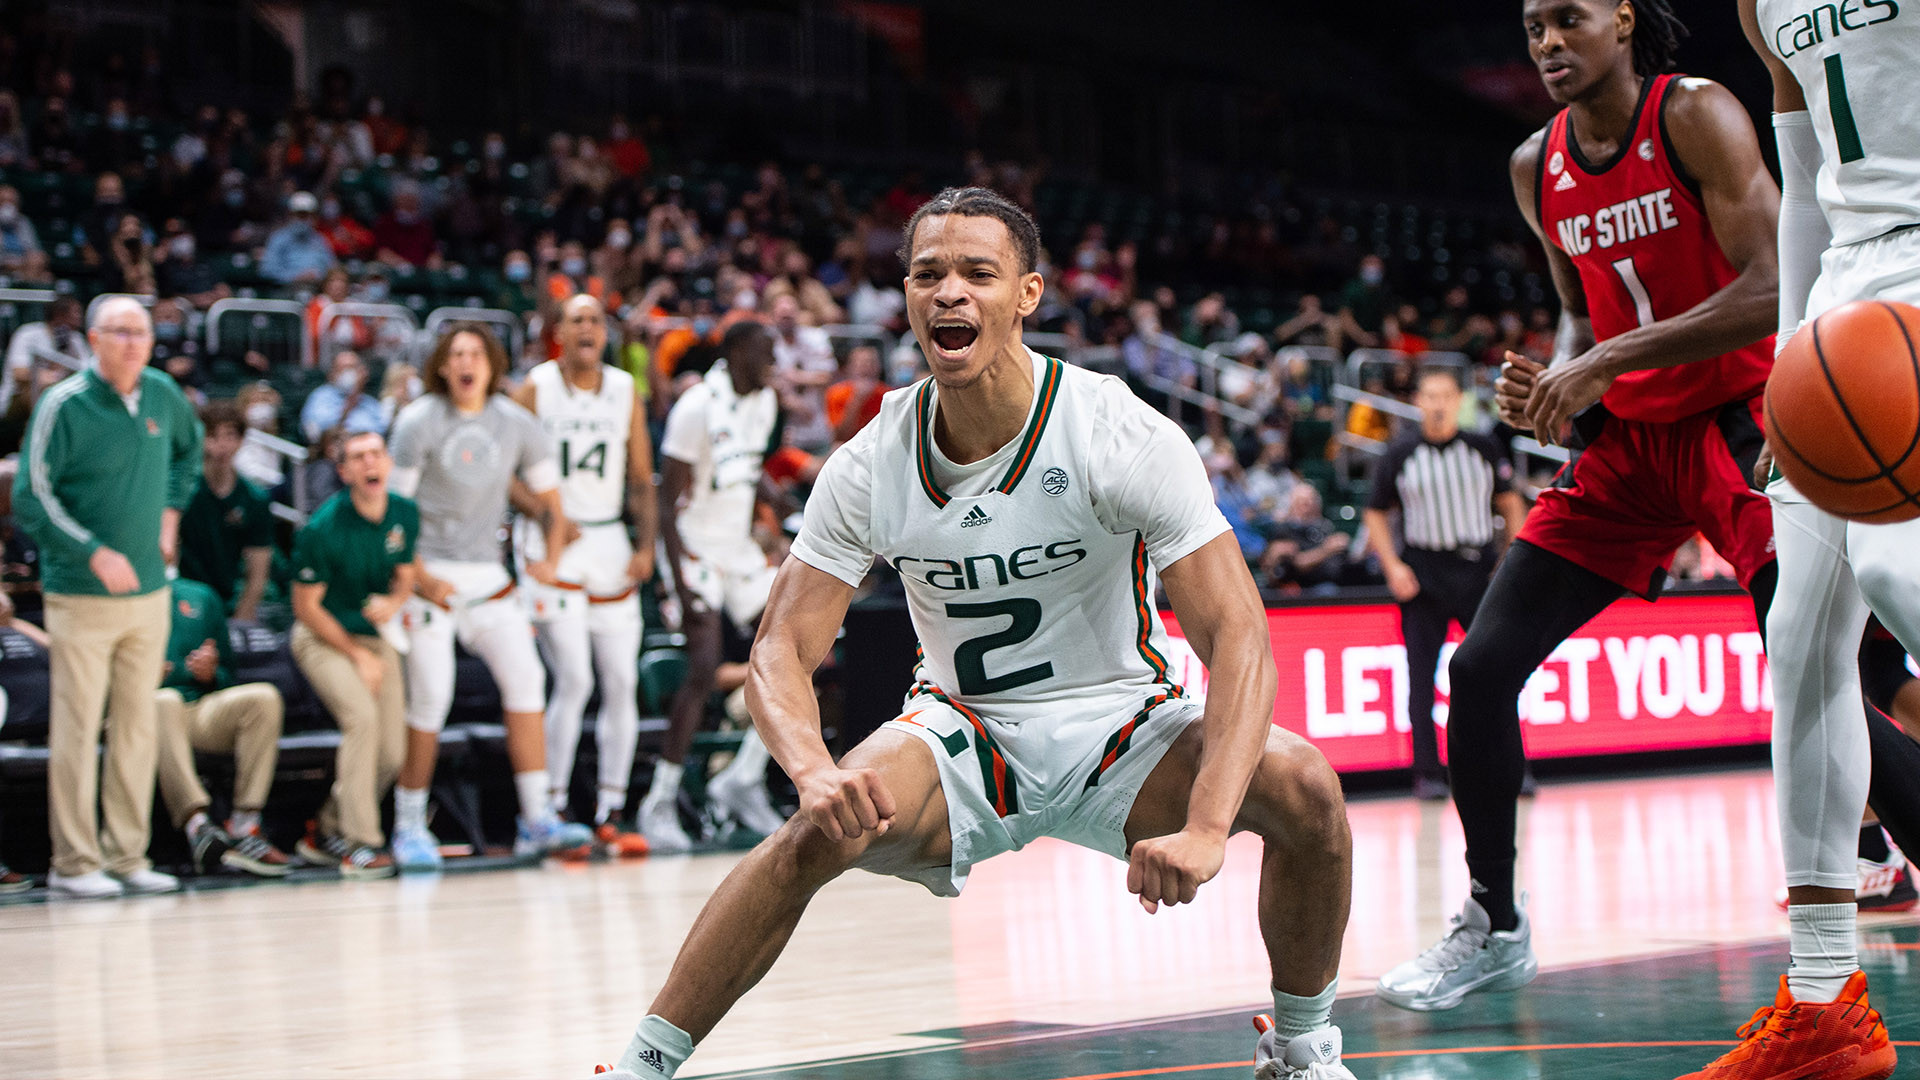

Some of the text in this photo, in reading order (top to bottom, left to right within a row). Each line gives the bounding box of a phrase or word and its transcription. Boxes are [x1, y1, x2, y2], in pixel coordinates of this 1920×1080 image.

[1823, 53, 1865, 164] 1
[1556, 187, 1680, 258] NC STATE
[1611, 255, 1657, 328] 1
[560, 439, 607, 478] 14
[960, 515, 993, 529] adidas
[944, 597, 1055, 696] 2
[1304, 642, 1459, 739] LET
[1517, 637, 1600, 725] ET
[1603, 632, 1726, 720] YOU
[638, 1051, 665, 1072] adidas
